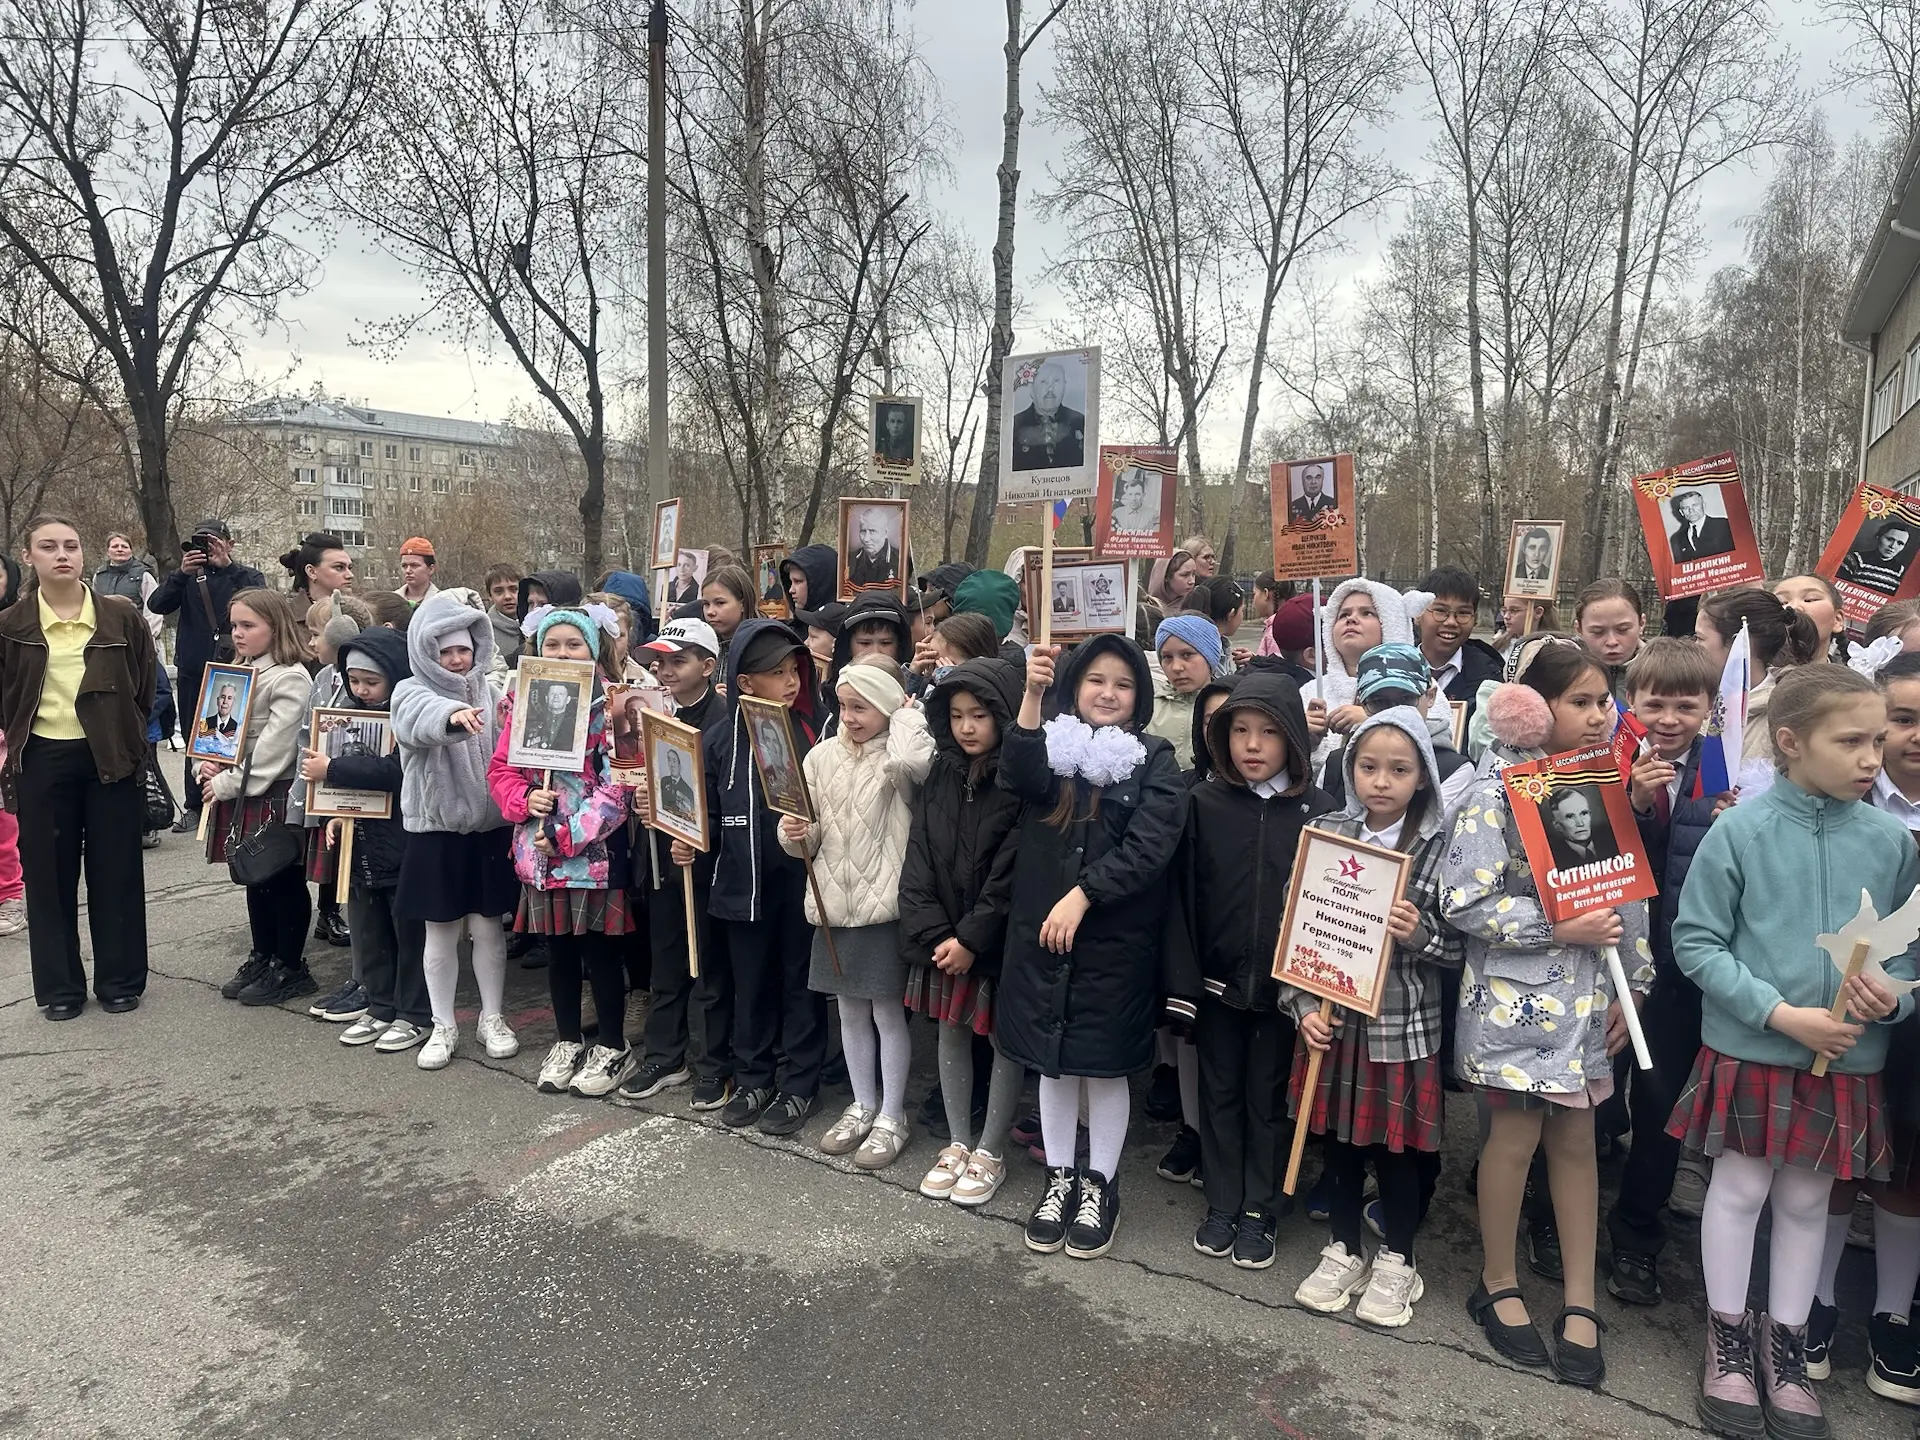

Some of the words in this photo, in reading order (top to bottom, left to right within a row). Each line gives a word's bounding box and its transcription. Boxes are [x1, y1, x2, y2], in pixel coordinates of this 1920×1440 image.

[1682, 460, 1717, 476] БЕССМЕРТНЫЙ
[1718, 457, 1732, 465] ПОЛК
[1031, 475, 1071, 485] Кузнецов
[1004, 490, 1040, 500] Николай
[1042, 488, 1092, 497] Игнатьевич
[1555, 749, 1595, 768] БЕССМЕРТНЫЙ
[1595, 747, 1611, 758] ПОЛК
[1332, 886, 1359, 901] ПОЛК
[1606, 889, 1624, 901] ВОВ
[1302, 889, 1384, 924] Константинов
[1315, 910, 1367, 935] Николай
[1302, 922, 1373, 954] Гермонович
[1314, 940, 1330, 951] 1923
[1337, 948, 1354, 959] 1996
